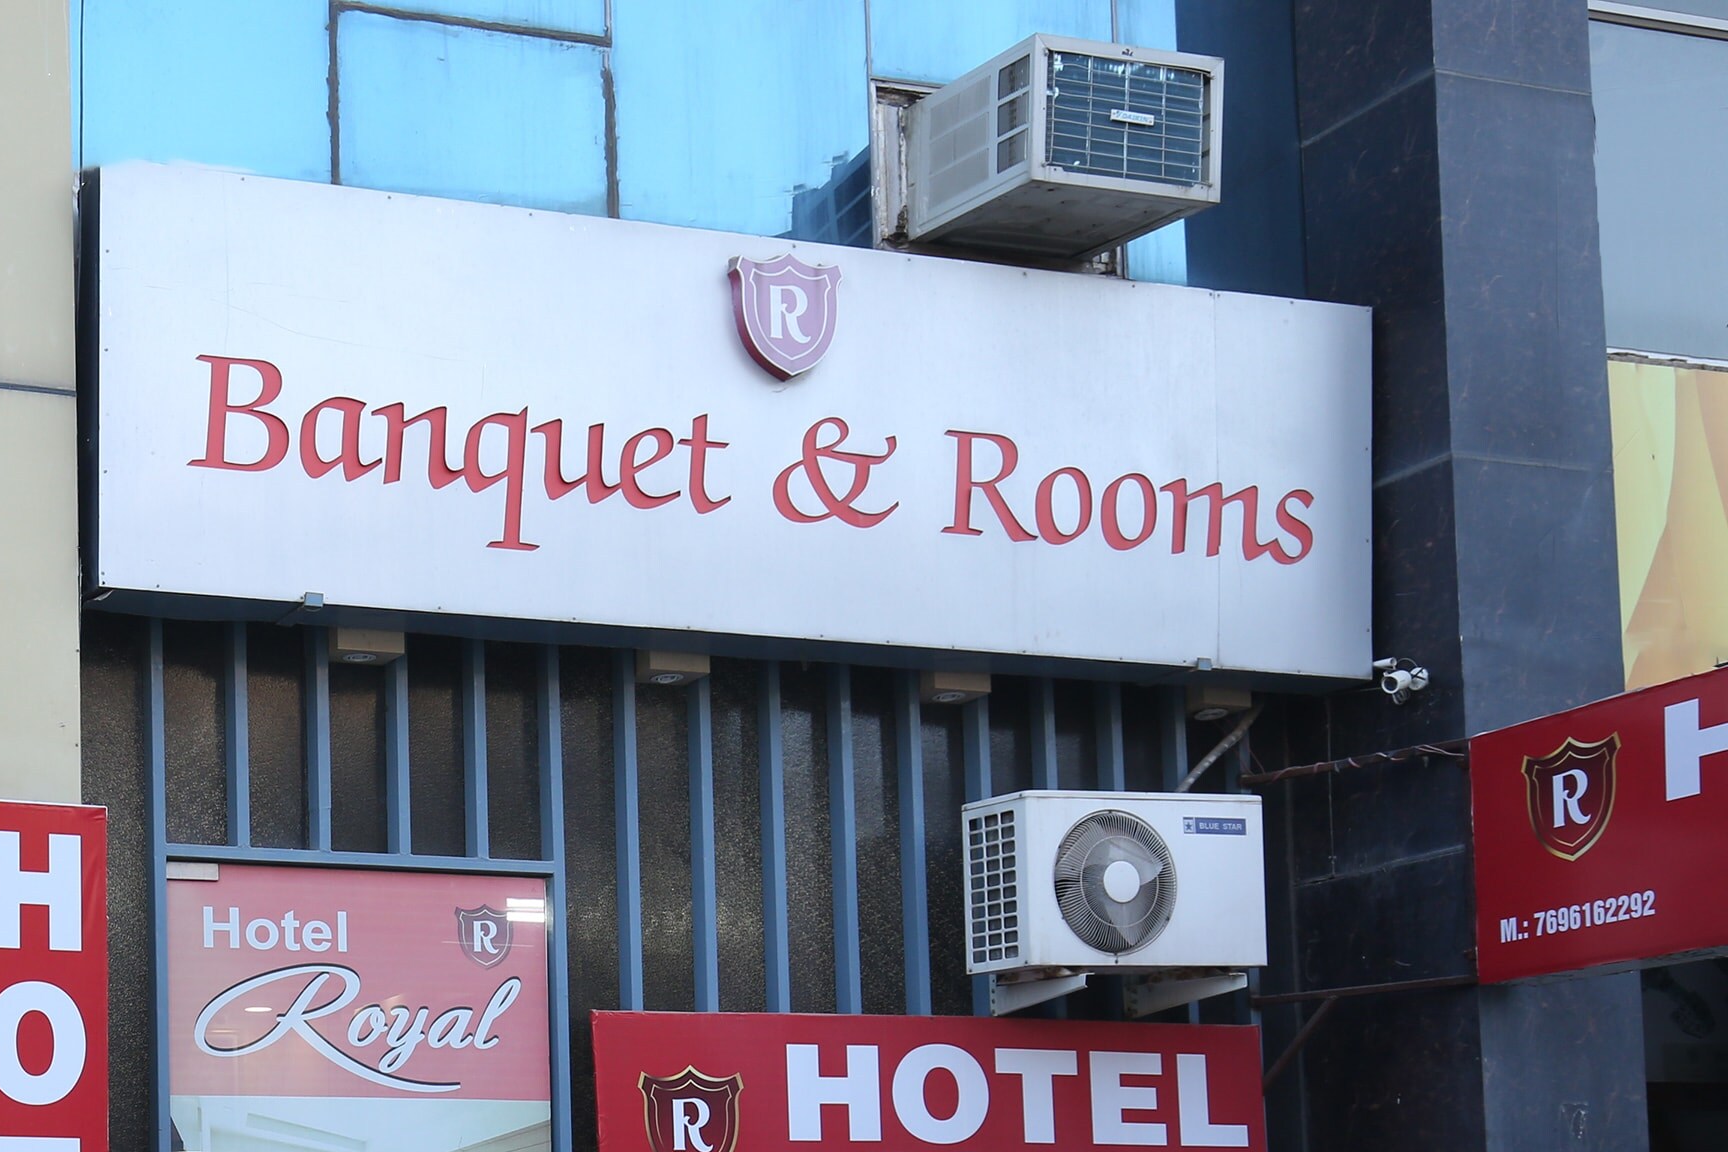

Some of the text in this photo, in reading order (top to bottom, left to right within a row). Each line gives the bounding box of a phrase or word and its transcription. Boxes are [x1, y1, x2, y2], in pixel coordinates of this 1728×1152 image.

[768, 285, 811, 346] R
[187, 355, 1314, 565] Banquet & Rooms
[1199, 822, 1242, 831] BLUE STAR
[1553, 769, 1591, 828] R
[203, 906, 347, 952] Hotel
[474, 921, 499, 953] R
[1533, 890, 1656, 937] 7696162292
[194, 962, 521, 1092] Royal
[786, 1044, 1248, 1146] HOTEL
[673, 1097, 714, 1152] R
